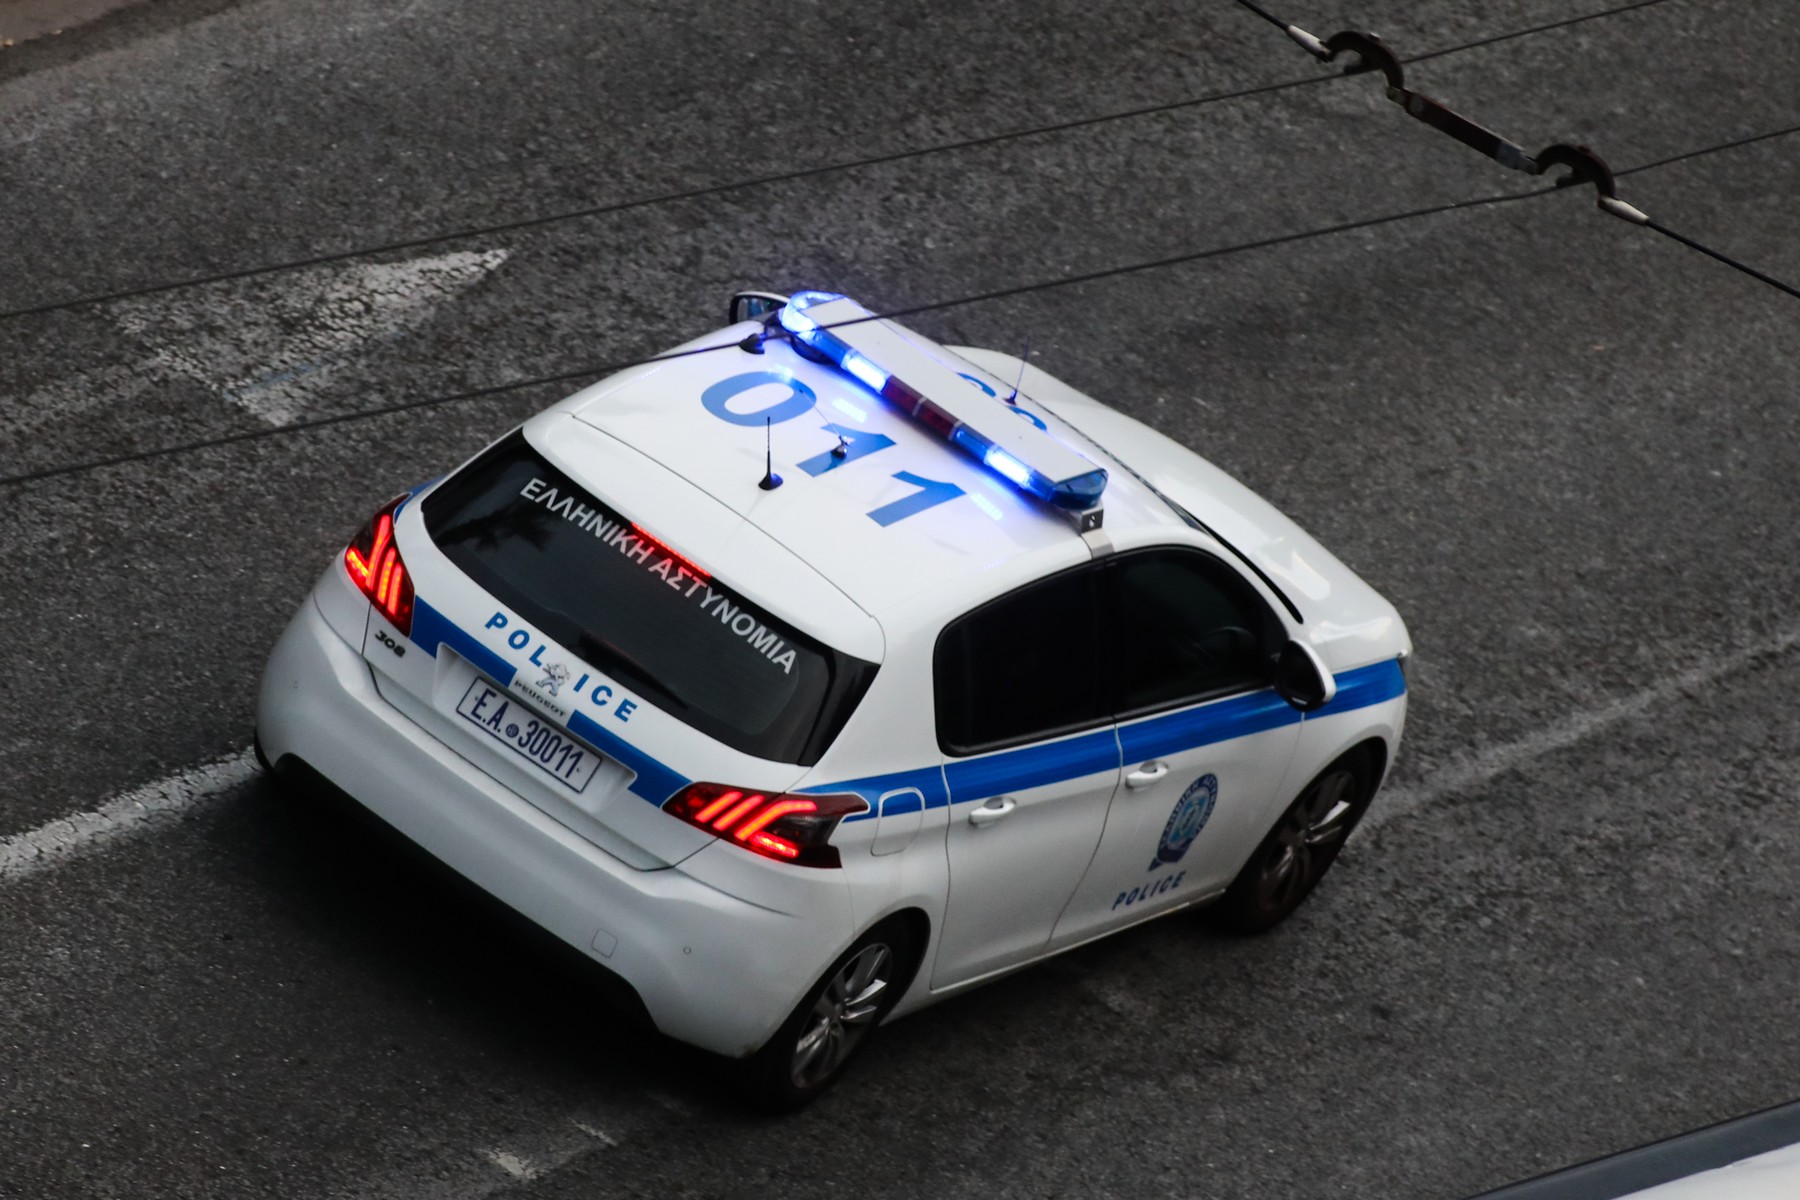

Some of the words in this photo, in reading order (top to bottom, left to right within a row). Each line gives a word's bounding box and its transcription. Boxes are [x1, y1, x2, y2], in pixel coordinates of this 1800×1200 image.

[701, 371, 966, 527] 011
[520, 478, 654, 564] ΕΛΛΗΝΙΚΗ
[648, 558, 797, 675] ΑΣΤΥΝΟΜΙΑ
[375, 630, 406, 658] 308
[485, 612, 638, 722] POLICE
[514, 679, 566, 717] PEUGEOT
[518, 720, 584, 779] 30011
[1112, 870, 1187, 911] POLICE
